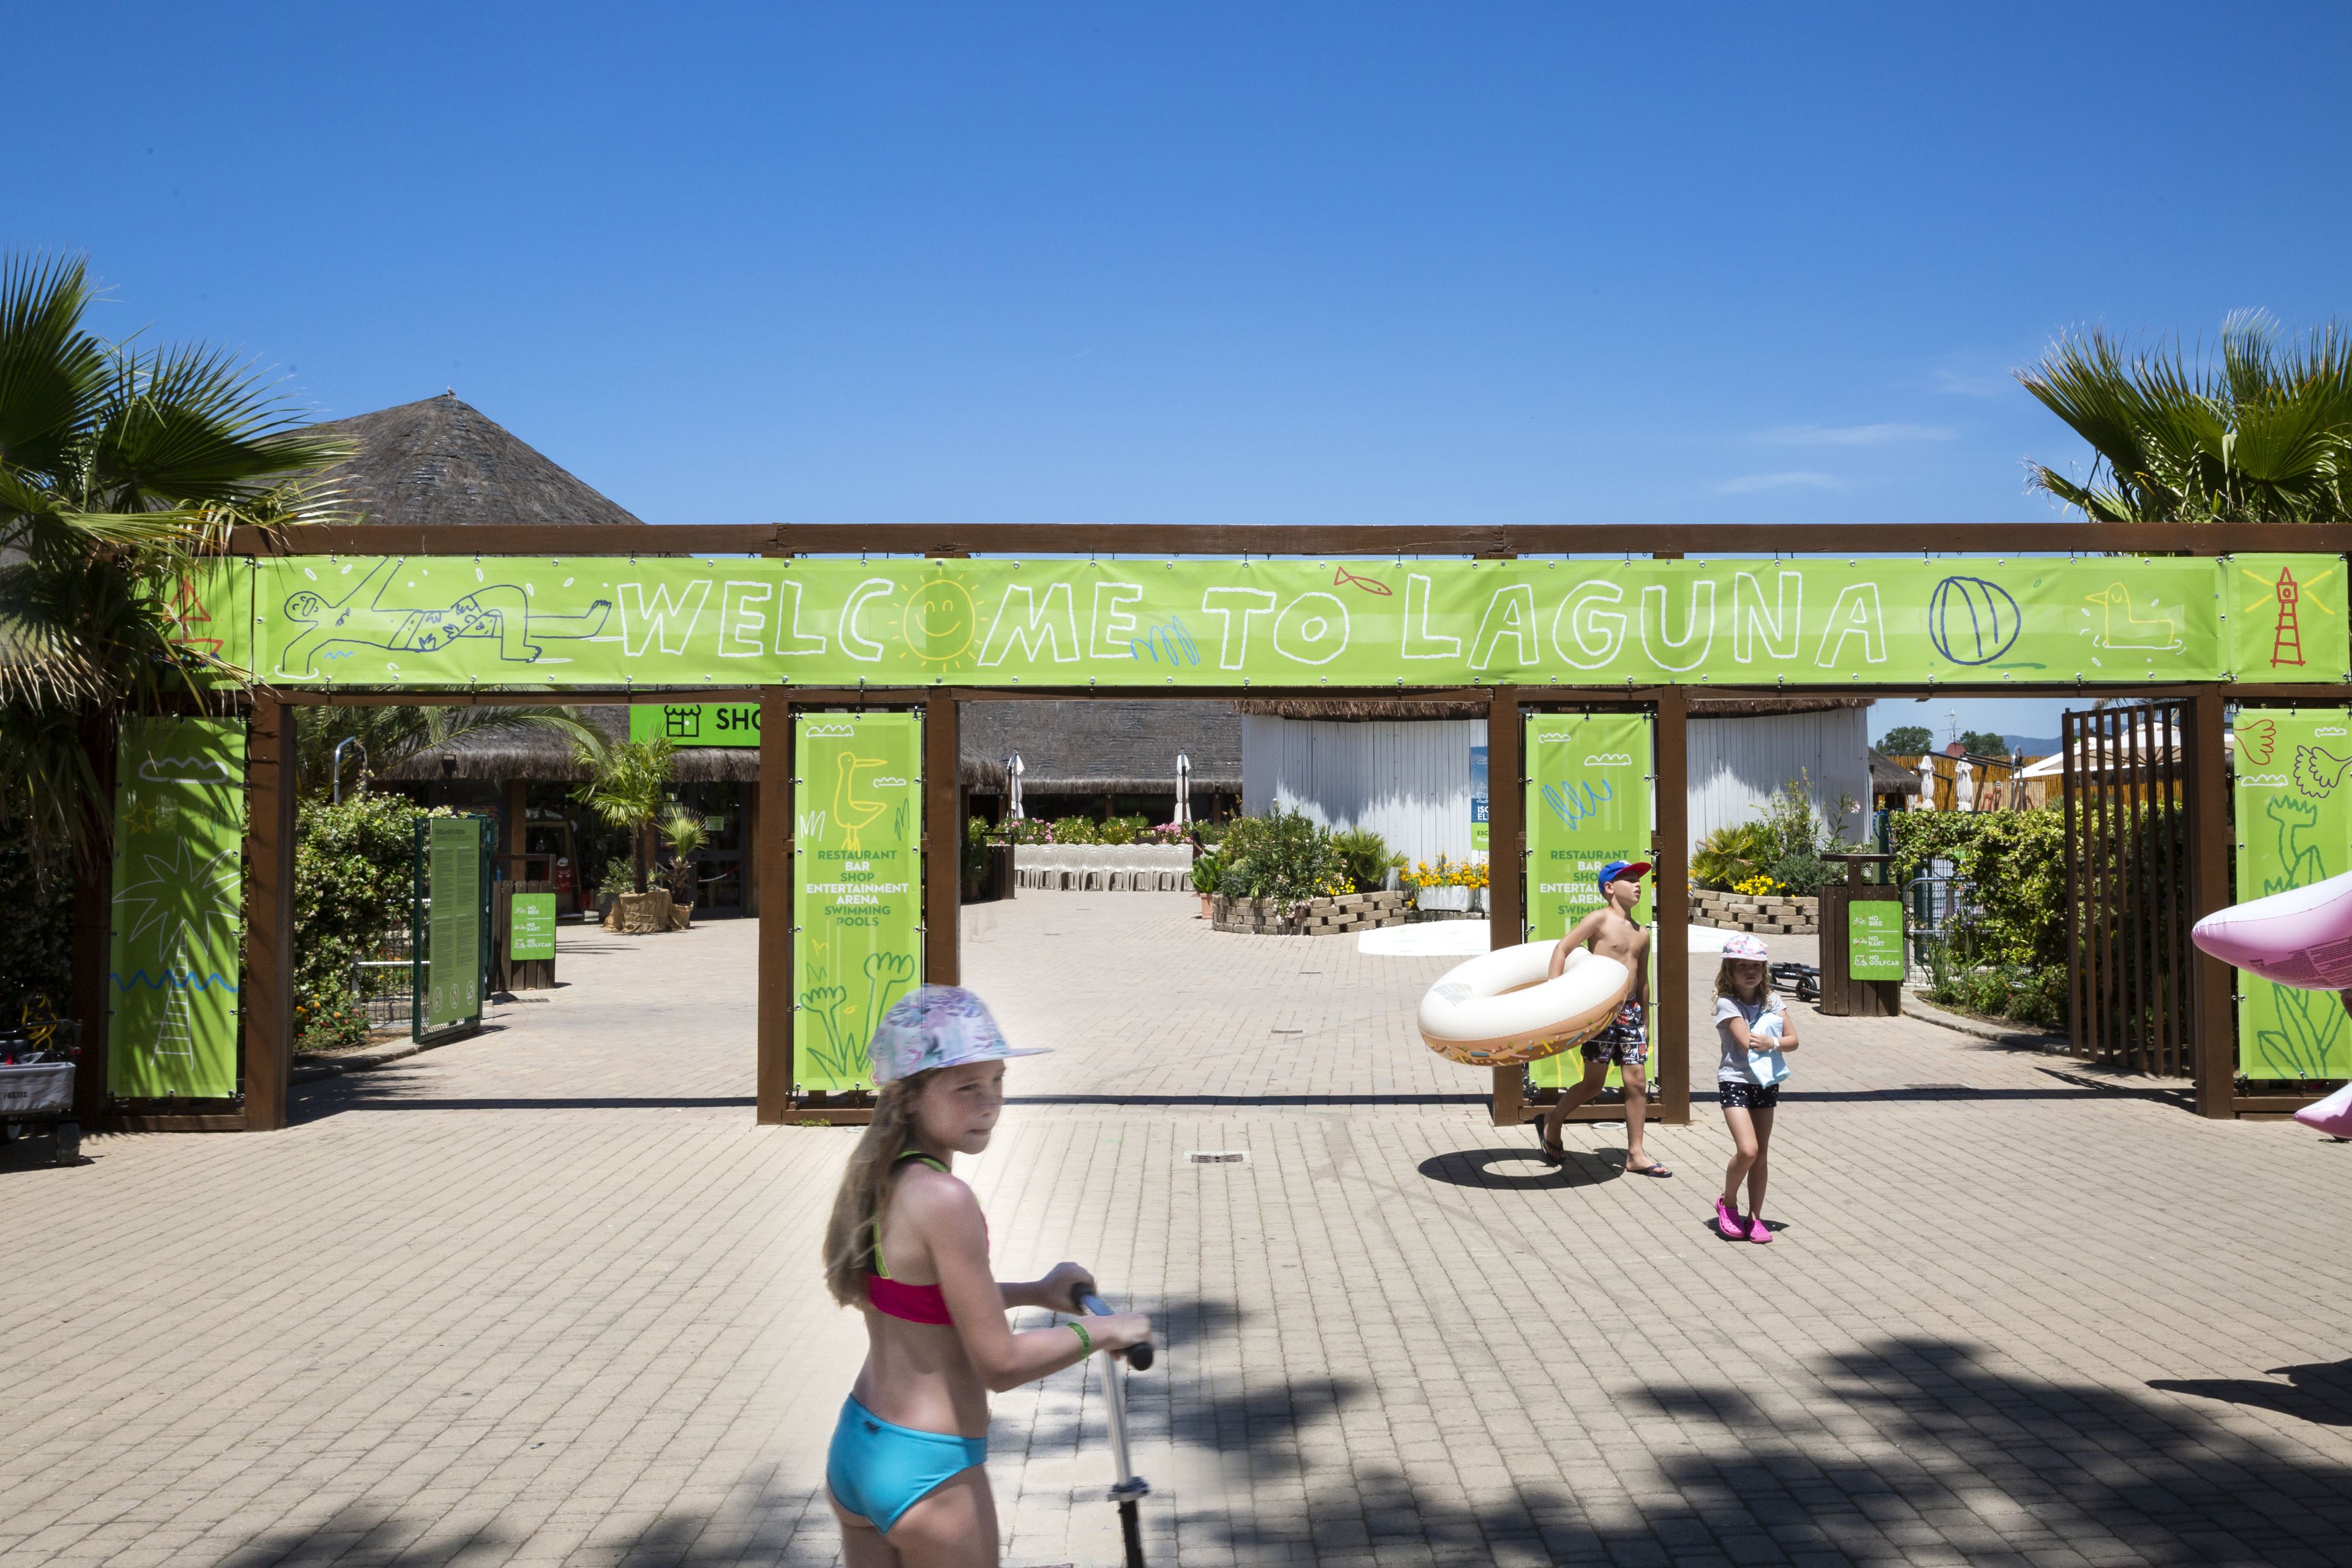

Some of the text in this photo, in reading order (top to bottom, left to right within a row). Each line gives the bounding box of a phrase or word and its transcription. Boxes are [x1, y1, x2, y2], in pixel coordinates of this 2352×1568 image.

[1202, 587, 1350, 670] TO
[1401, 571, 1888, 672] LAGUNA
[818, 850, 897, 860] RESTAURANT
[1551, 850, 1629, 860] RESTAURANT
[845, 861, 870, 871] BAR
[1578, 861, 1602, 871] BAR
[840, 873, 875, 882] SHOP
[806, 883, 909, 894] ENTERTAINMENT
[1540, 883, 1600, 894] ENTERTAI
[836, 895, 879, 905] ARENA
[824, 906, 891, 915] SWIMMING
[837, 917, 878, 926] POOLS
